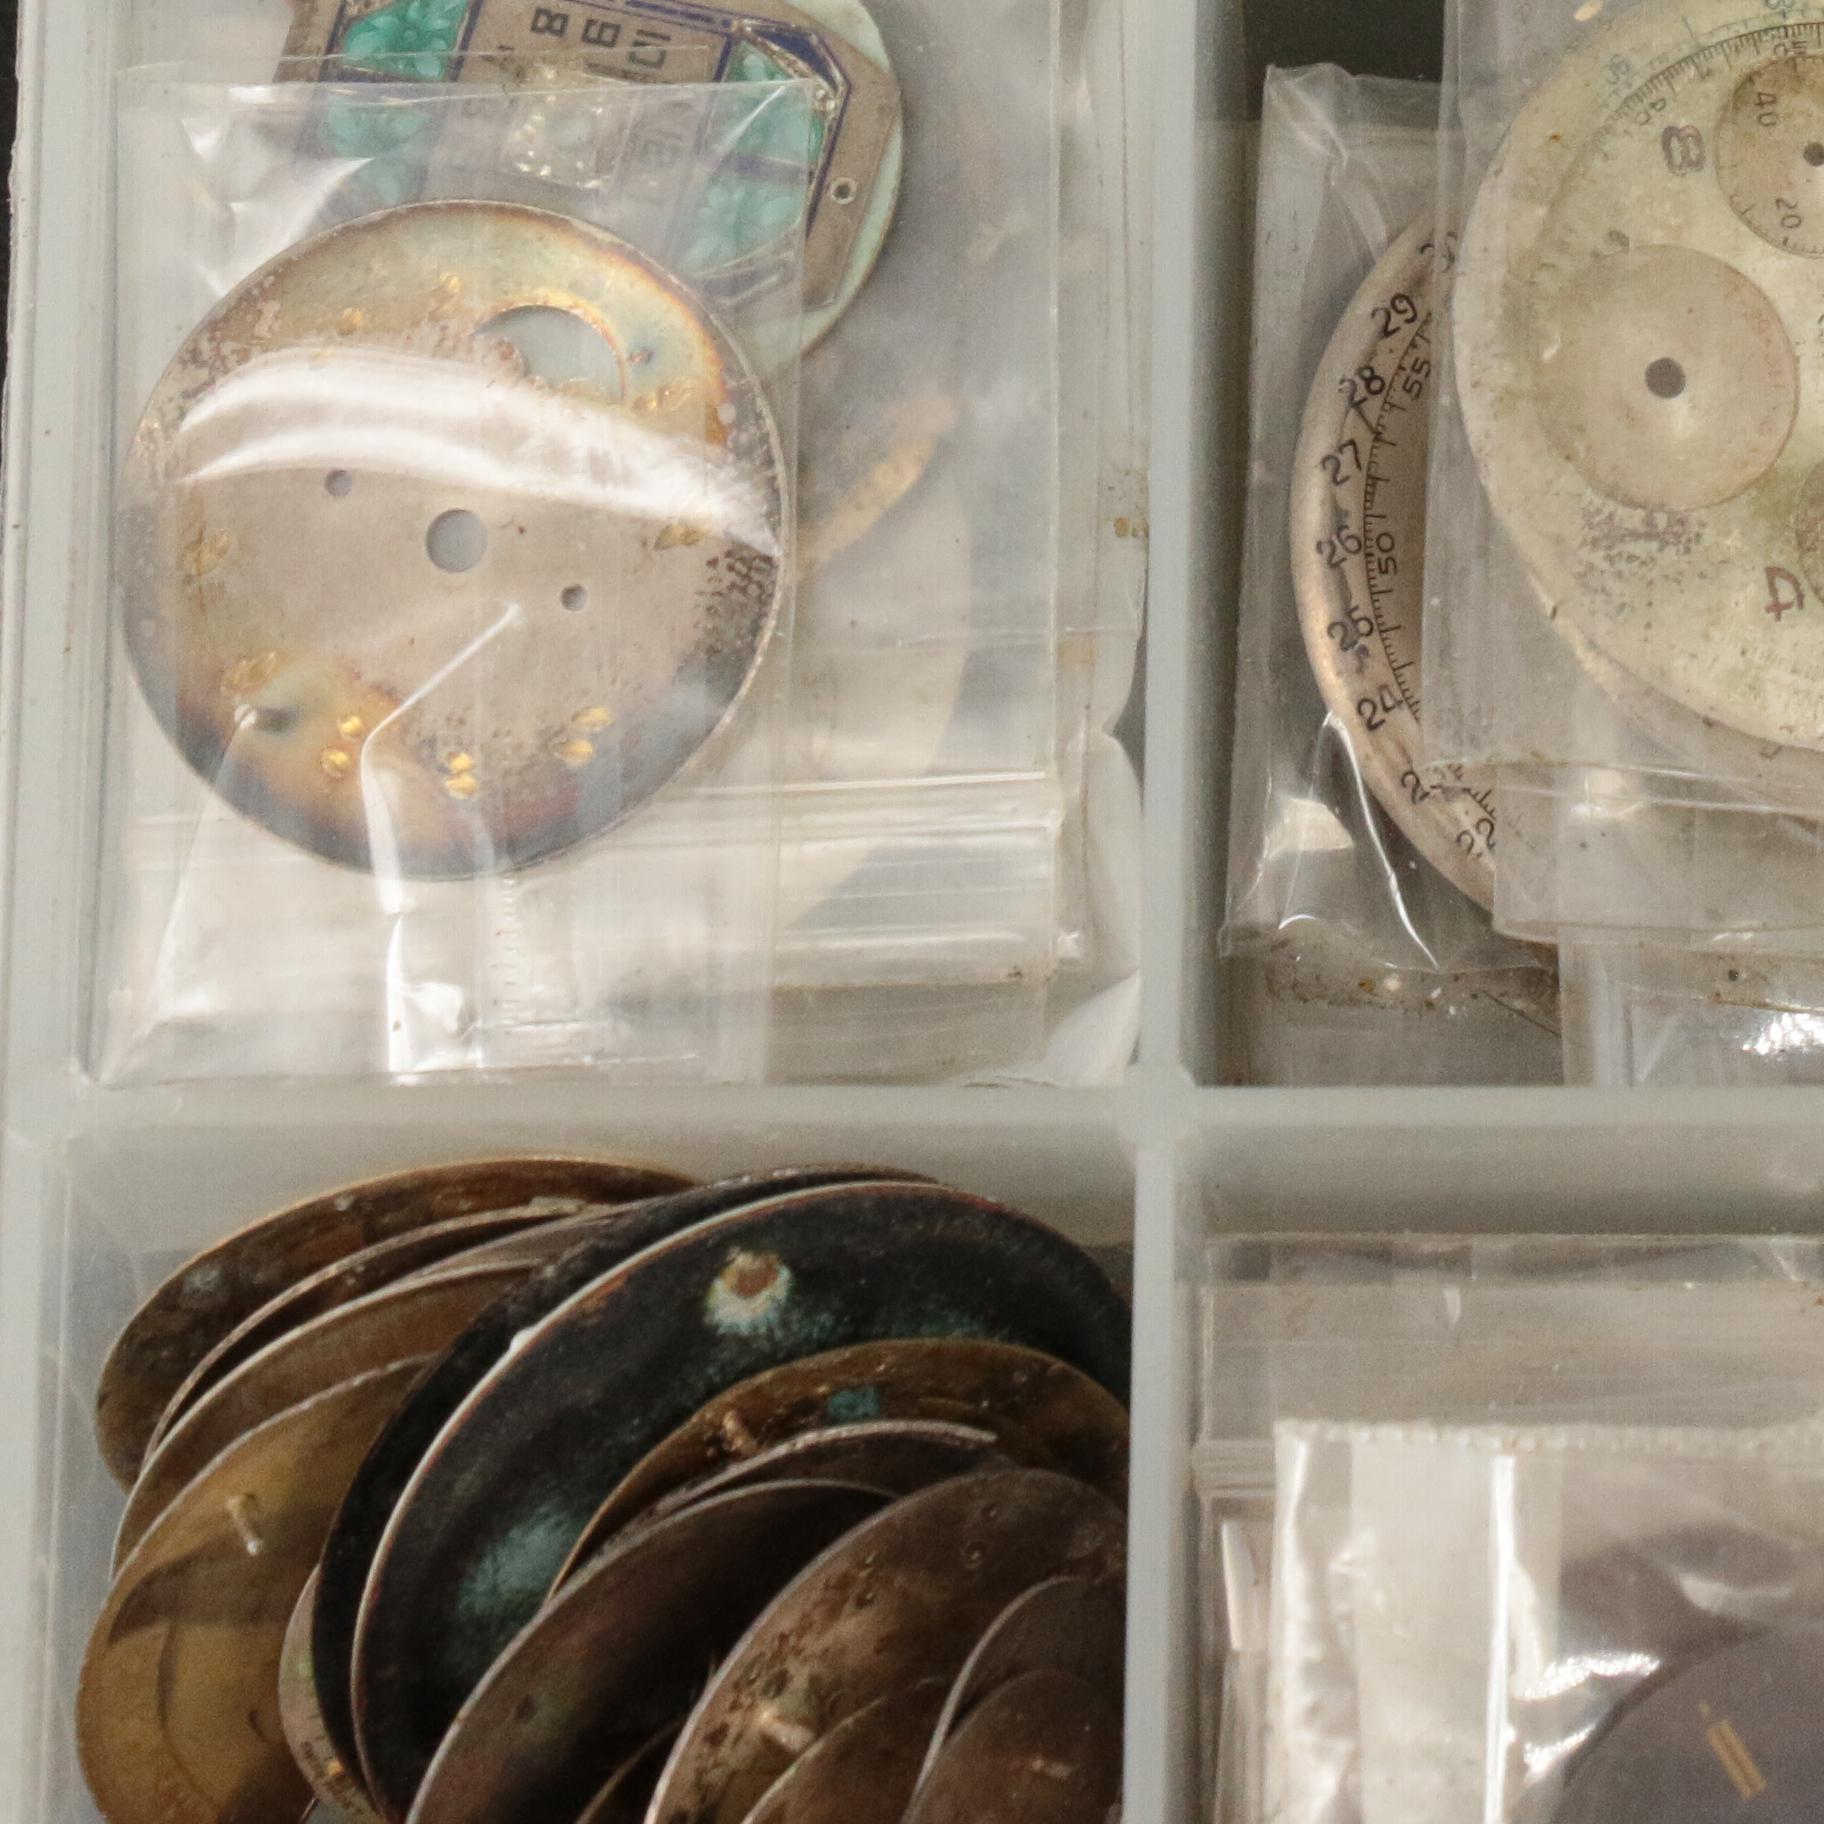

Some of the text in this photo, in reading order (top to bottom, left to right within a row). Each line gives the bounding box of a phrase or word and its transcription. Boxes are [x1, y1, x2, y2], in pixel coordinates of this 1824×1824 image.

[1661, 124, 1706, 177] 8
[1773, 196, 1803, 229] 20
[1371, 292, 1417, 338] 29
[1337, 365, 1386, 410] 28
[1403, 357, 1432, 400] 55
[1320, 439, 1362, 486] 27
[1315, 524, 1362, 570] 26
[1376, 531, 1398, 576] 50
[1764, 565, 1805, 622] 4
[1326, 605, 1374, 653] 25
[1356, 683, 1404, 732] 24
